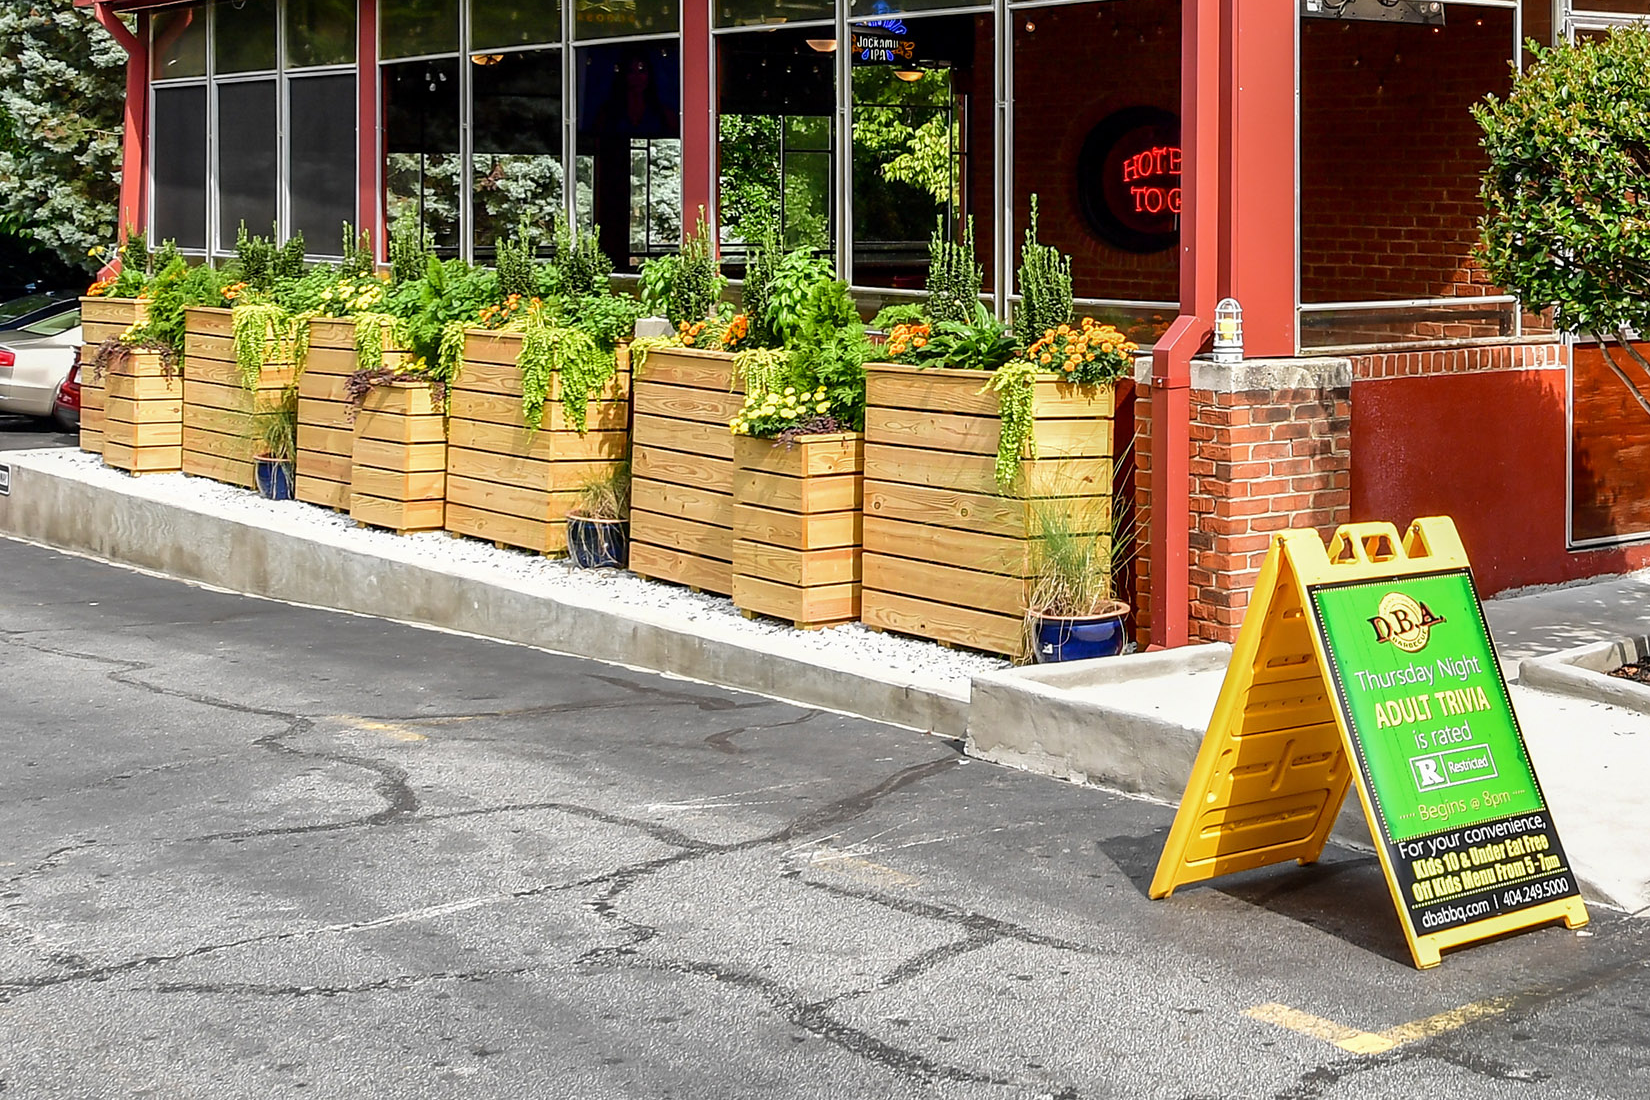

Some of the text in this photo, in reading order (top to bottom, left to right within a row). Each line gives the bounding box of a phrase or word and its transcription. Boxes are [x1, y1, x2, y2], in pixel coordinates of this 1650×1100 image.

[871, 49, 886, 61] IPA
[1123, 146, 1167, 182] HOT
[1131, 186, 1162, 213] TO
[1366, 601, 1447, 644] D.B.A.
[1392, 629, 1428, 648] BARBECUE
[1354, 655, 1482, 692] Thursday Night
[1374, 685, 1492, 729] ADULT TRIVIA
[1412, 719, 1473, 750] is rated
[1415, 755, 1489, 786] R Restricted
[1418, 790, 1511, 821] Begins @ 8pm
[1398, 815, 1546, 859] For your convenience,
[1411, 833, 1549, 880] Kids 10 & Under Eat Free
[1411, 878, 1434, 903] Off
[1431, 875, 1462, 898] Kids
[1461, 867, 1496, 892] Menu
[1494, 861, 1527, 882] From
[1421, 899, 1490, 928] dbabbq.com
[1503, 877, 1569, 906] 404.249.5000
